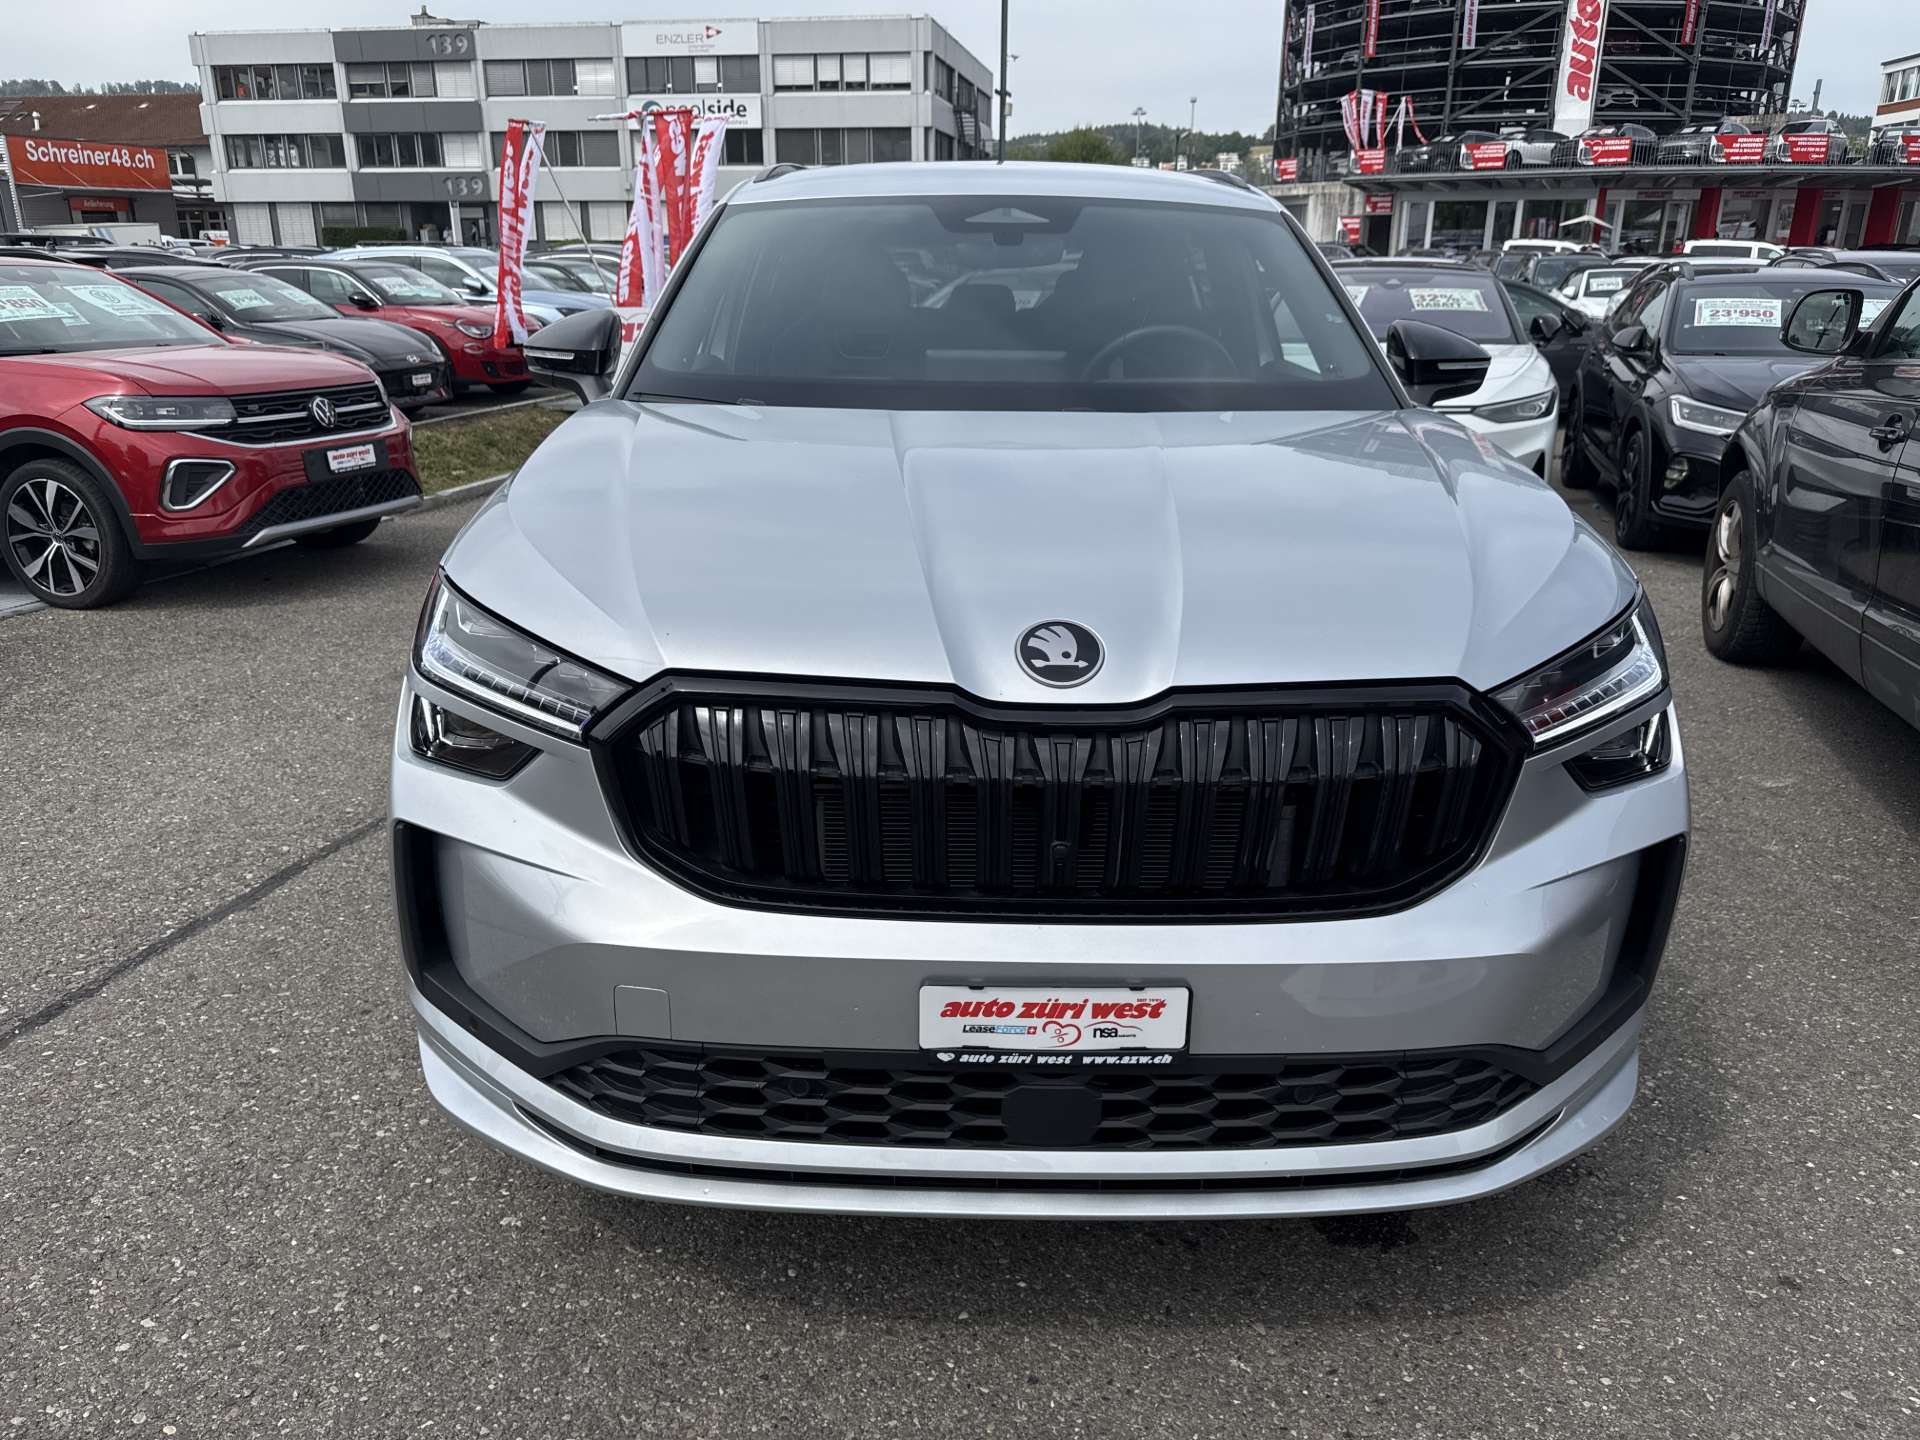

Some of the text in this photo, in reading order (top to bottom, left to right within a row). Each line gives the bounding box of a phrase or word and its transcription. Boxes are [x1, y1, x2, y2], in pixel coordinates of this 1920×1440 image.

[426, 33, 468, 54] 139
[655, 33, 704, 45] ENZLER
[1567, 0, 1601, 101] auto
[25, 139, 155, 169] Schreiner48.ch
[442, 176, 483, 196] 139
[1416, 302, 1462, 310] RABATT
[1709, 308, 1775, 318] 23'950
[940, 998, 1168, 1019] auto züri west
[962, 1024, 1118, 1038] LeaseForce nsa
[959, 1052, 1173, 1065] auto züri west www.azw.ch
